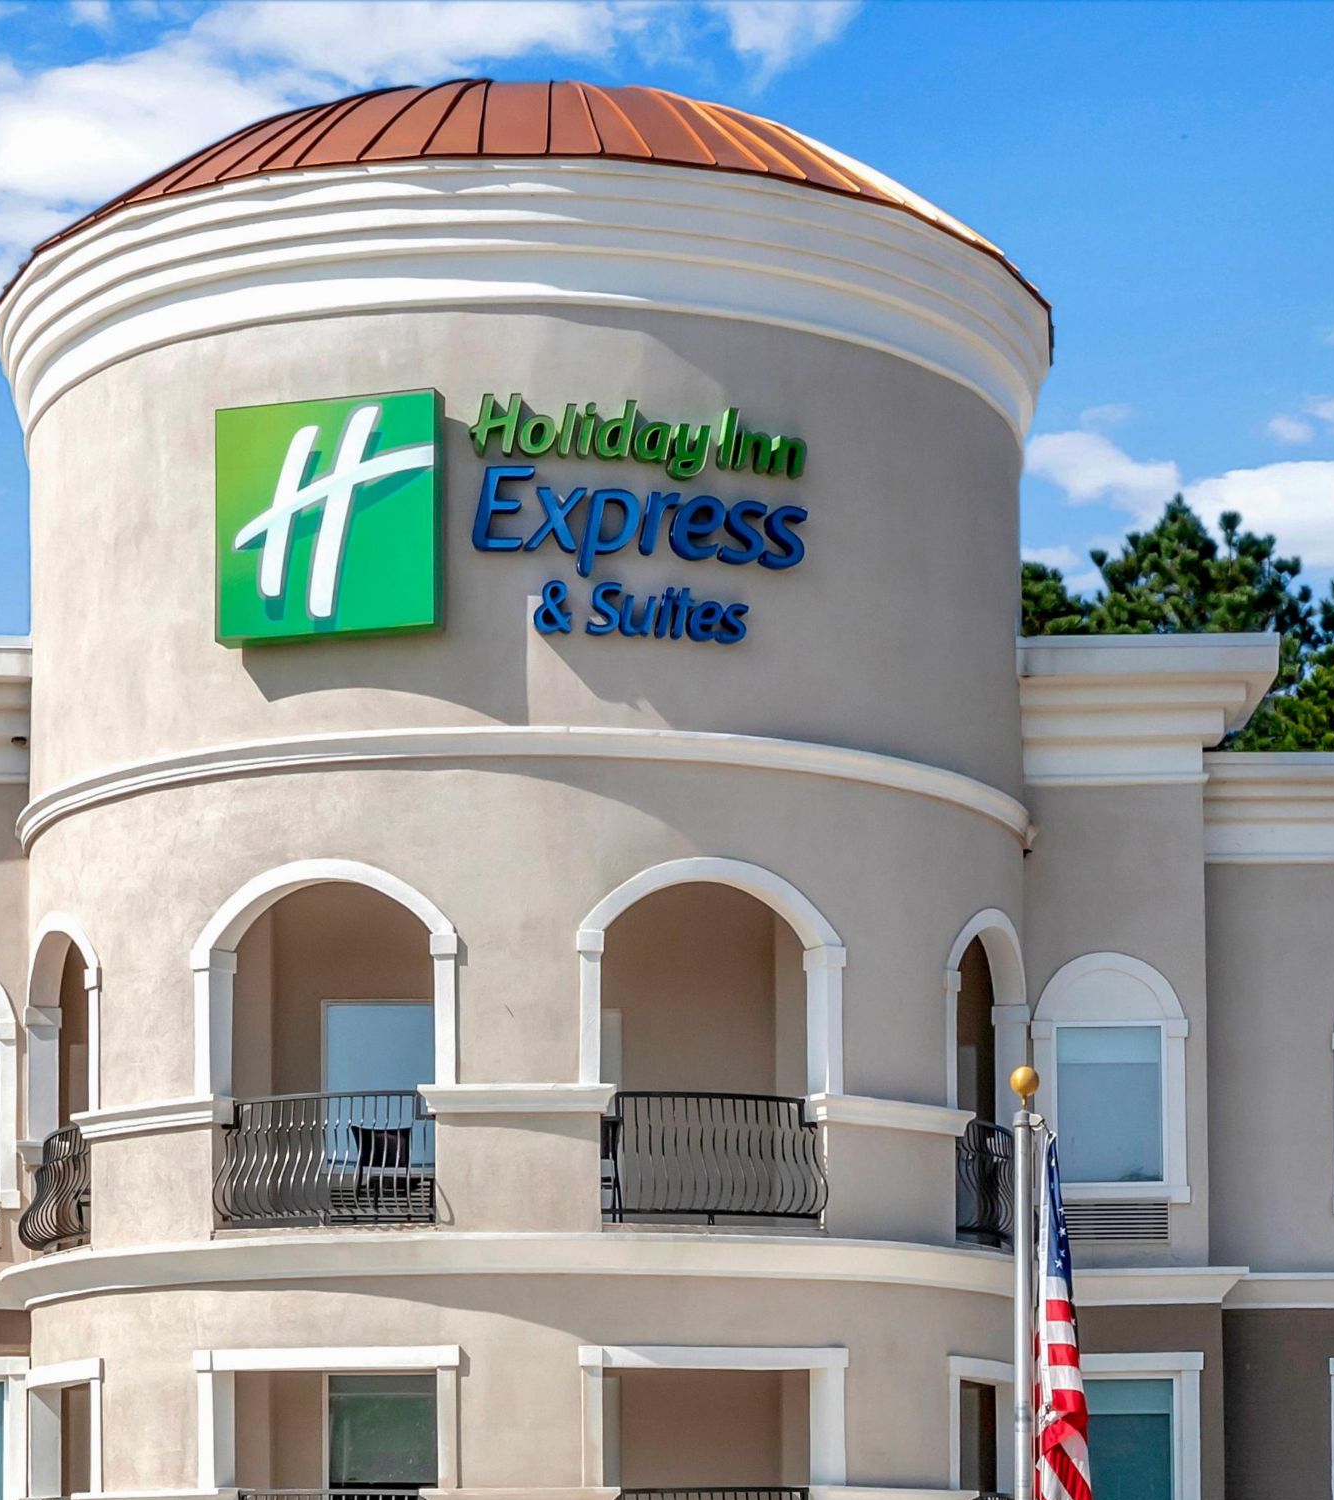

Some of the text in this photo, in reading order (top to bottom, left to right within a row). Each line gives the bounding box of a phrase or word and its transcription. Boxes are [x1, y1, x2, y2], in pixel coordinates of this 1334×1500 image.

[470, 393, 807, 480] Holiday Inn
[472, 465, 808, 577] Express
[534, 580, 749, 643] & Suites
